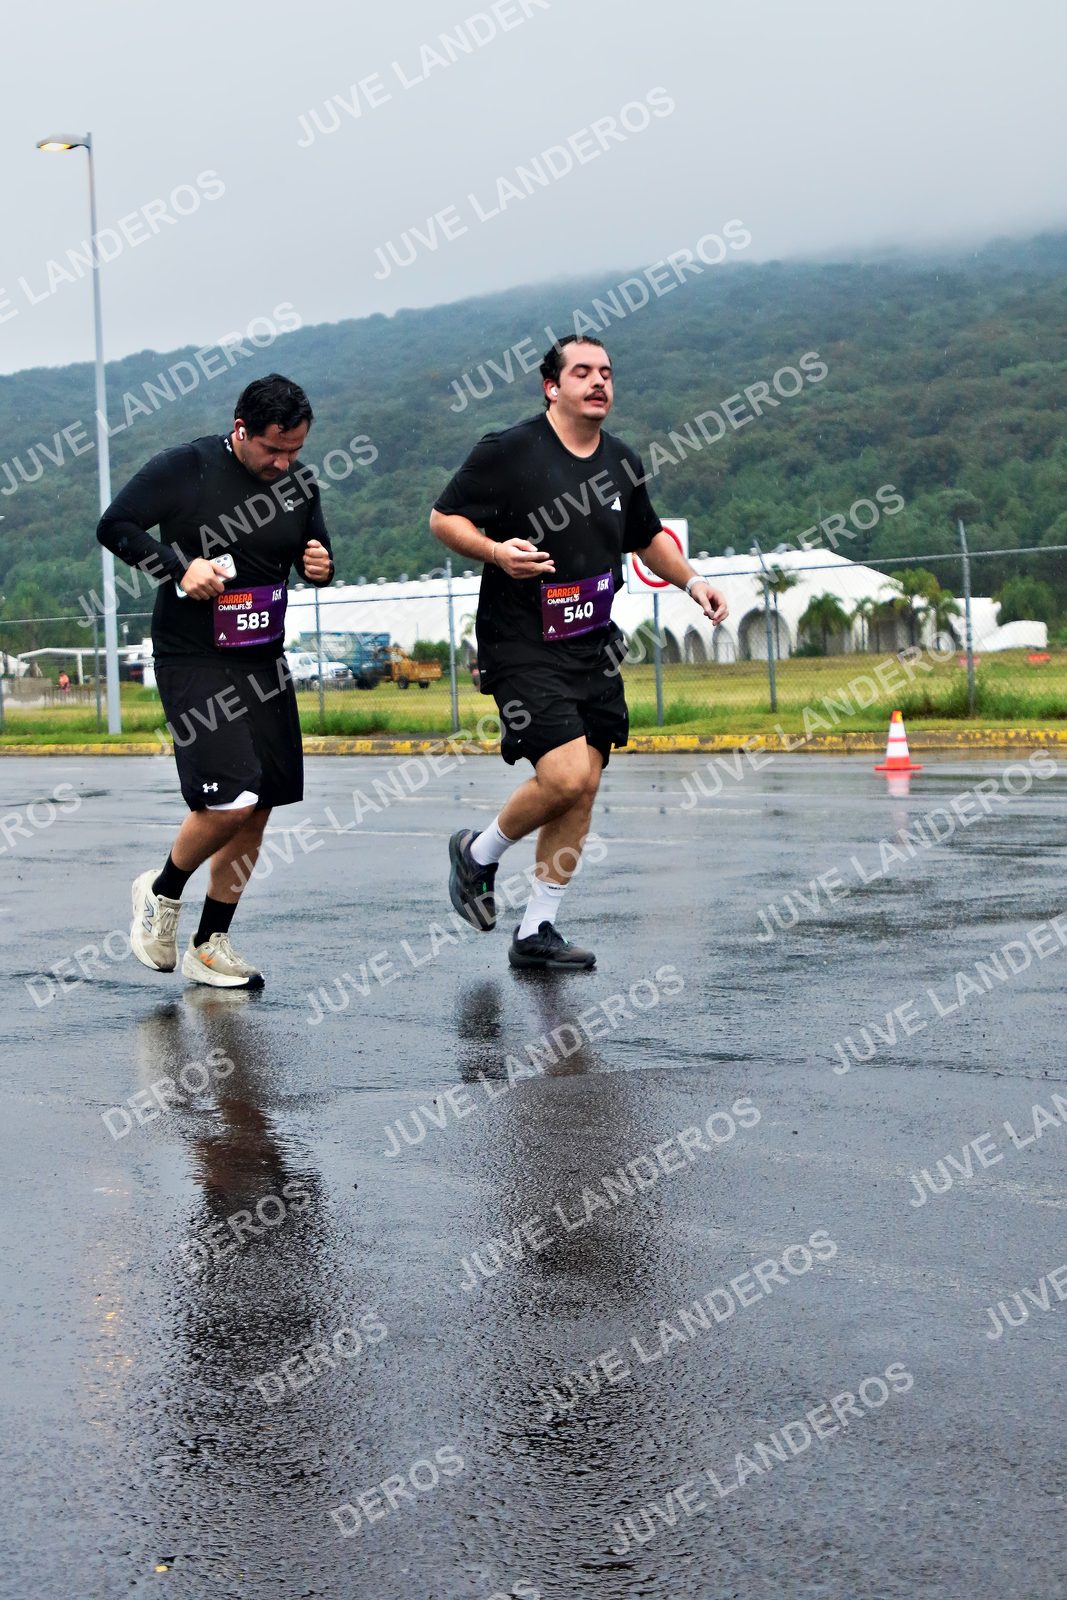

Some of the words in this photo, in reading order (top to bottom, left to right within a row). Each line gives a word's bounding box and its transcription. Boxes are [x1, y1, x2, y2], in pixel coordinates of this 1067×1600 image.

[218, 593, 252, 604] CARRERA
[547, 586, 580, 598] CARRERA
[564, 602, 594, 623] 540
[237, 611, 269, 630] 583
